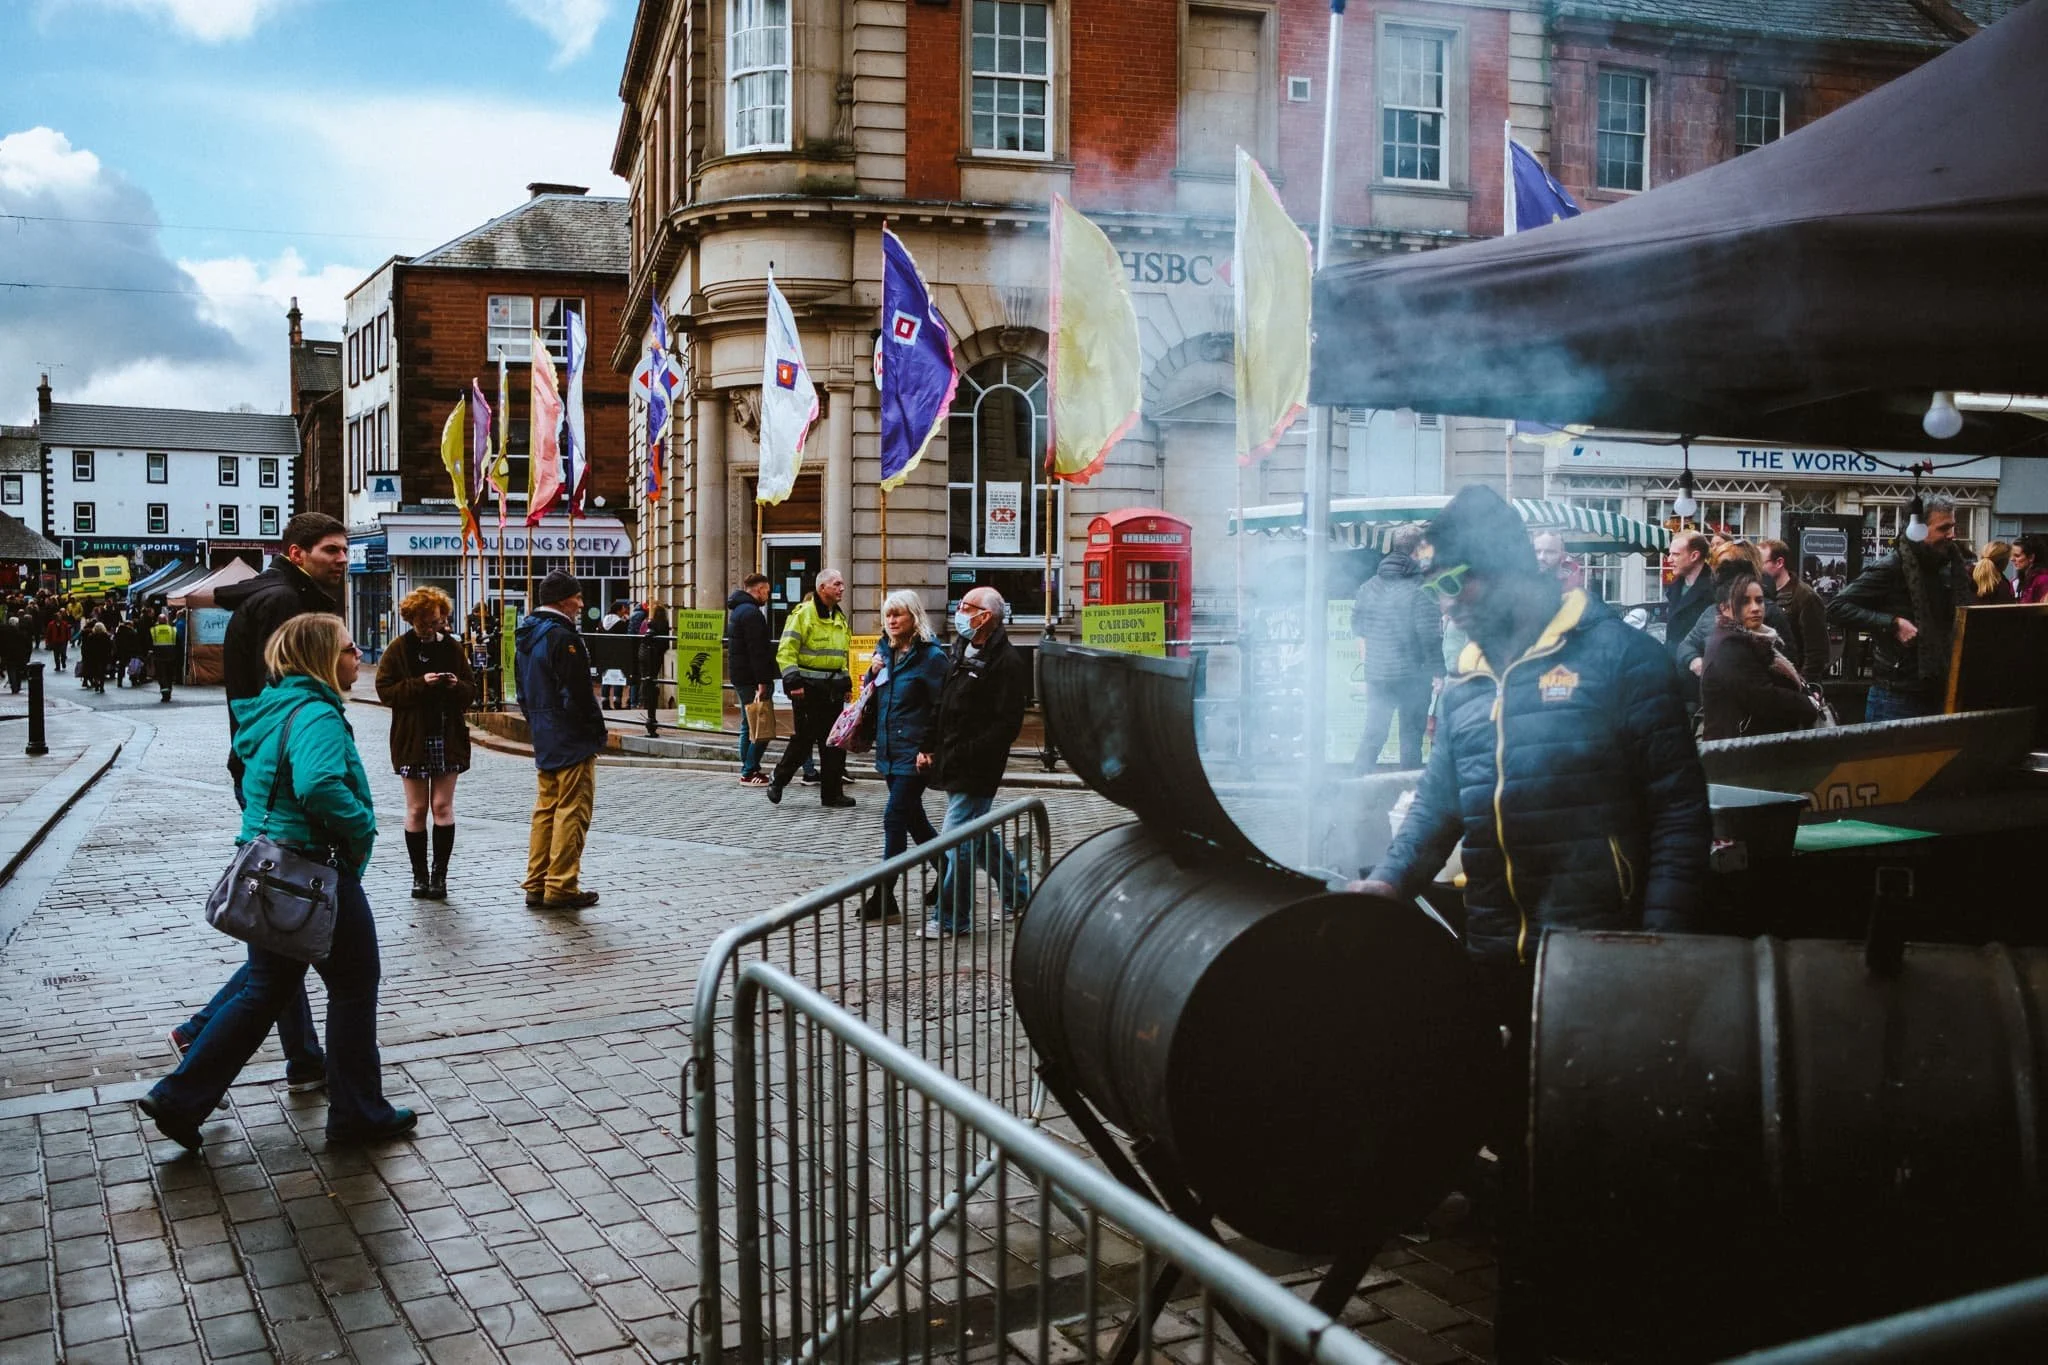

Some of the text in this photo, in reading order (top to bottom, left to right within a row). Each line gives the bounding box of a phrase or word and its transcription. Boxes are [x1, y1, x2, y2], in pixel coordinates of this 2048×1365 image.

[1118, 252, 1212, 285] HSBC
[1737, 450, 1877, 472] THE WORKS
[1124, 534, 1179, 543] TELEPHONE
[141, 543, 180, 551] SPORTS
[409, 536, 620, 554] SKIPTON BULDING SOCIETY
[1111, 608, 1127, 616] THE
[1099, 618, 1145, 630] CARBON
[1090, 632, 1157, 643] PRODUCER?
